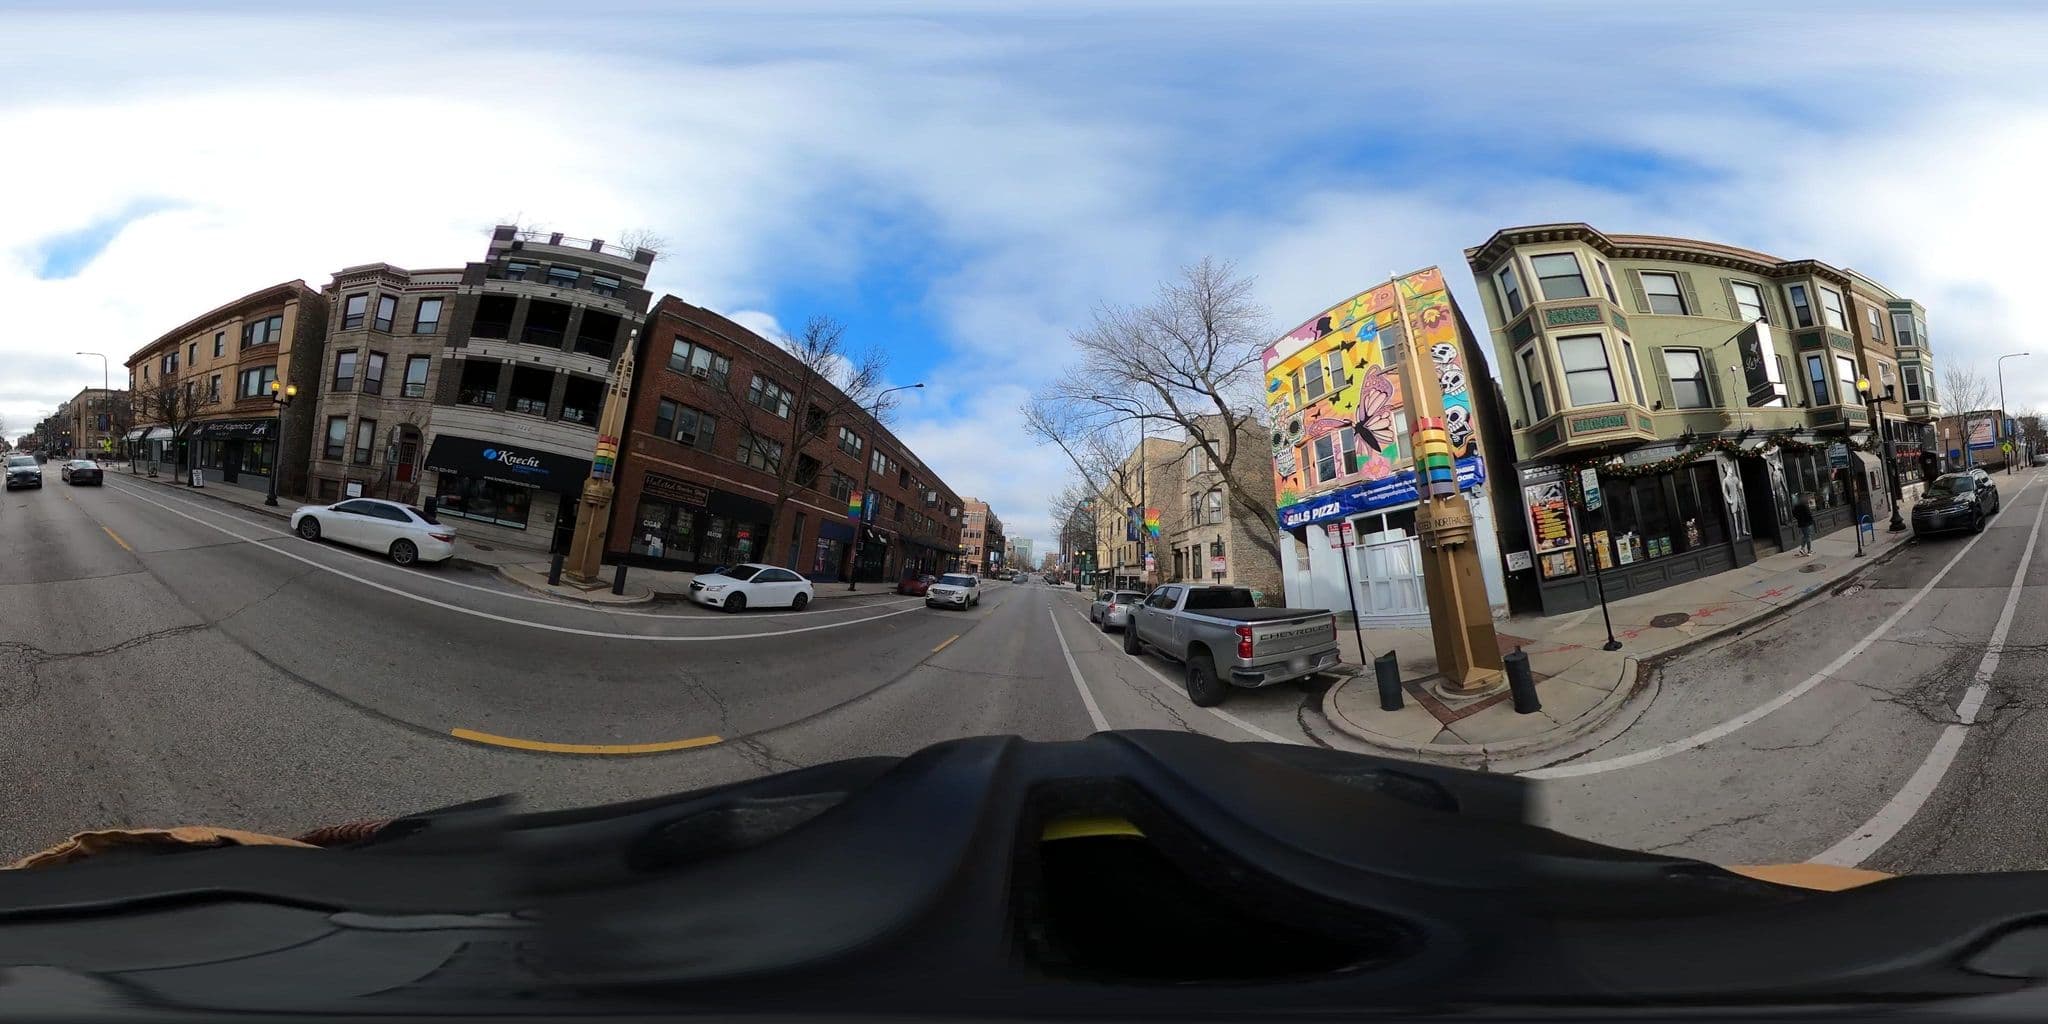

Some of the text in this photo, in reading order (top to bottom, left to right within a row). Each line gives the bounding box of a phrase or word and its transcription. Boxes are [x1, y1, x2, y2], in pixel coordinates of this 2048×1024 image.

[498, 450, 541, 468] Knecht
[1522, 463, 1561, 474] WOOD
[1287, 501, 1340, 526] SALS PIZZA
[643, 519, 662, 529] CIGAR
[1260, 624, 1329, 641] CHEVROLET
